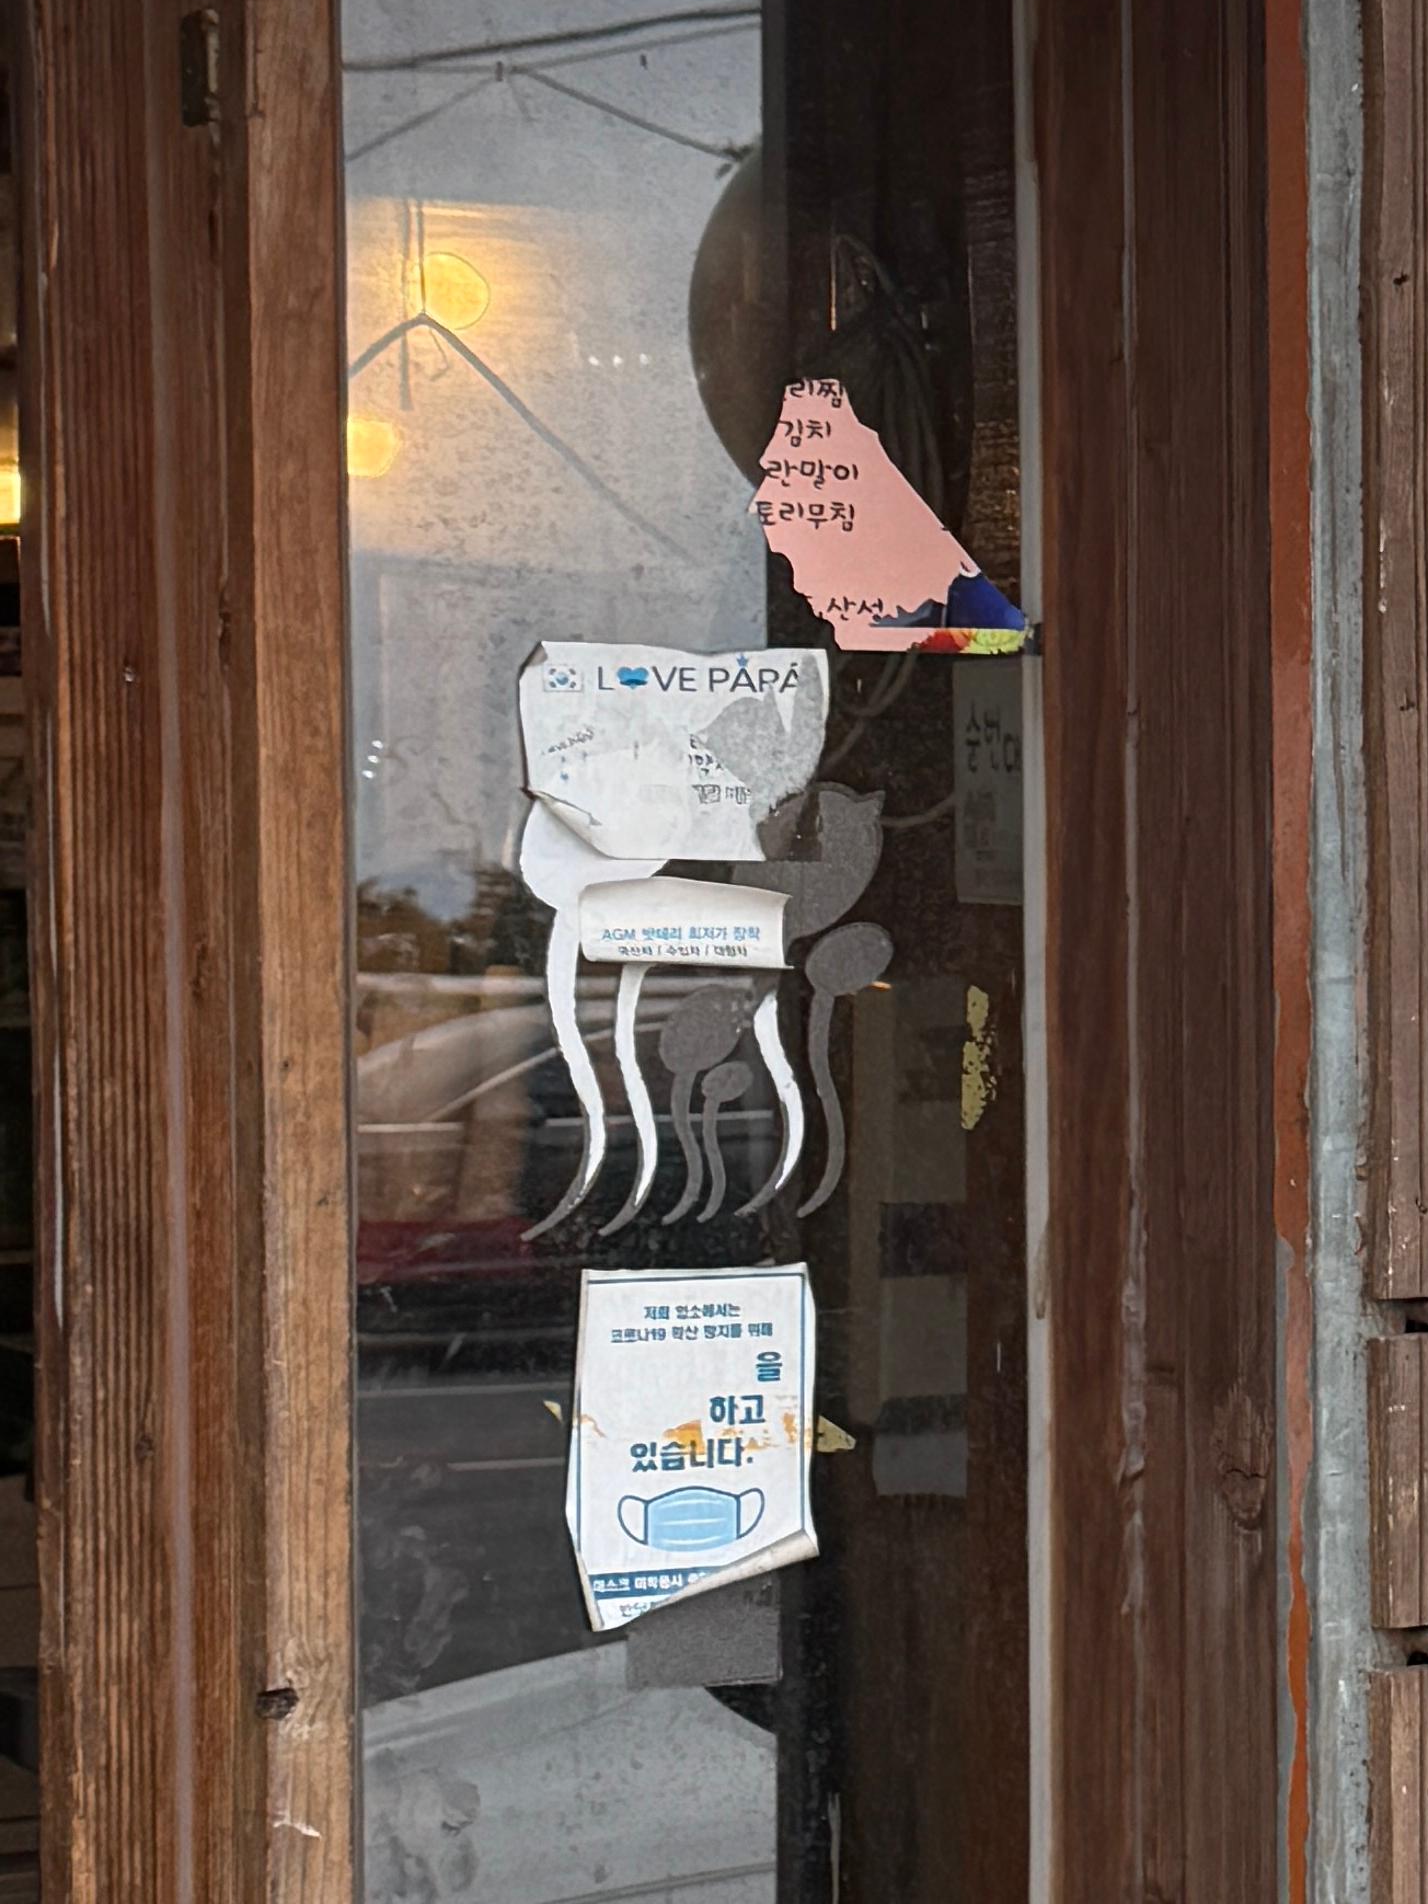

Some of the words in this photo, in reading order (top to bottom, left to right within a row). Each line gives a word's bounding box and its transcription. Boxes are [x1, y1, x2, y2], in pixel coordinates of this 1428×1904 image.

[788, 379, 845, 409] 리찜
[826, 596, 884, 623] 산성
[601, 927, 637, 942] AGM
[643, 1304, 671, 1321] 저희
[675, 1302, 741, 1321] 업소에서는
[610, 1326, 667, 1344] 코로나19
[671, 1325, 700, 1342] 확산
[703, 1322, 743, 1340] 방지를
[747, 1321, 774, 1338] 위해
[755, 1350, 783, 1383] 을
[709, 1394, 767, 1426] 하고
[629, 1436, 754, 1473] 있습니다.
